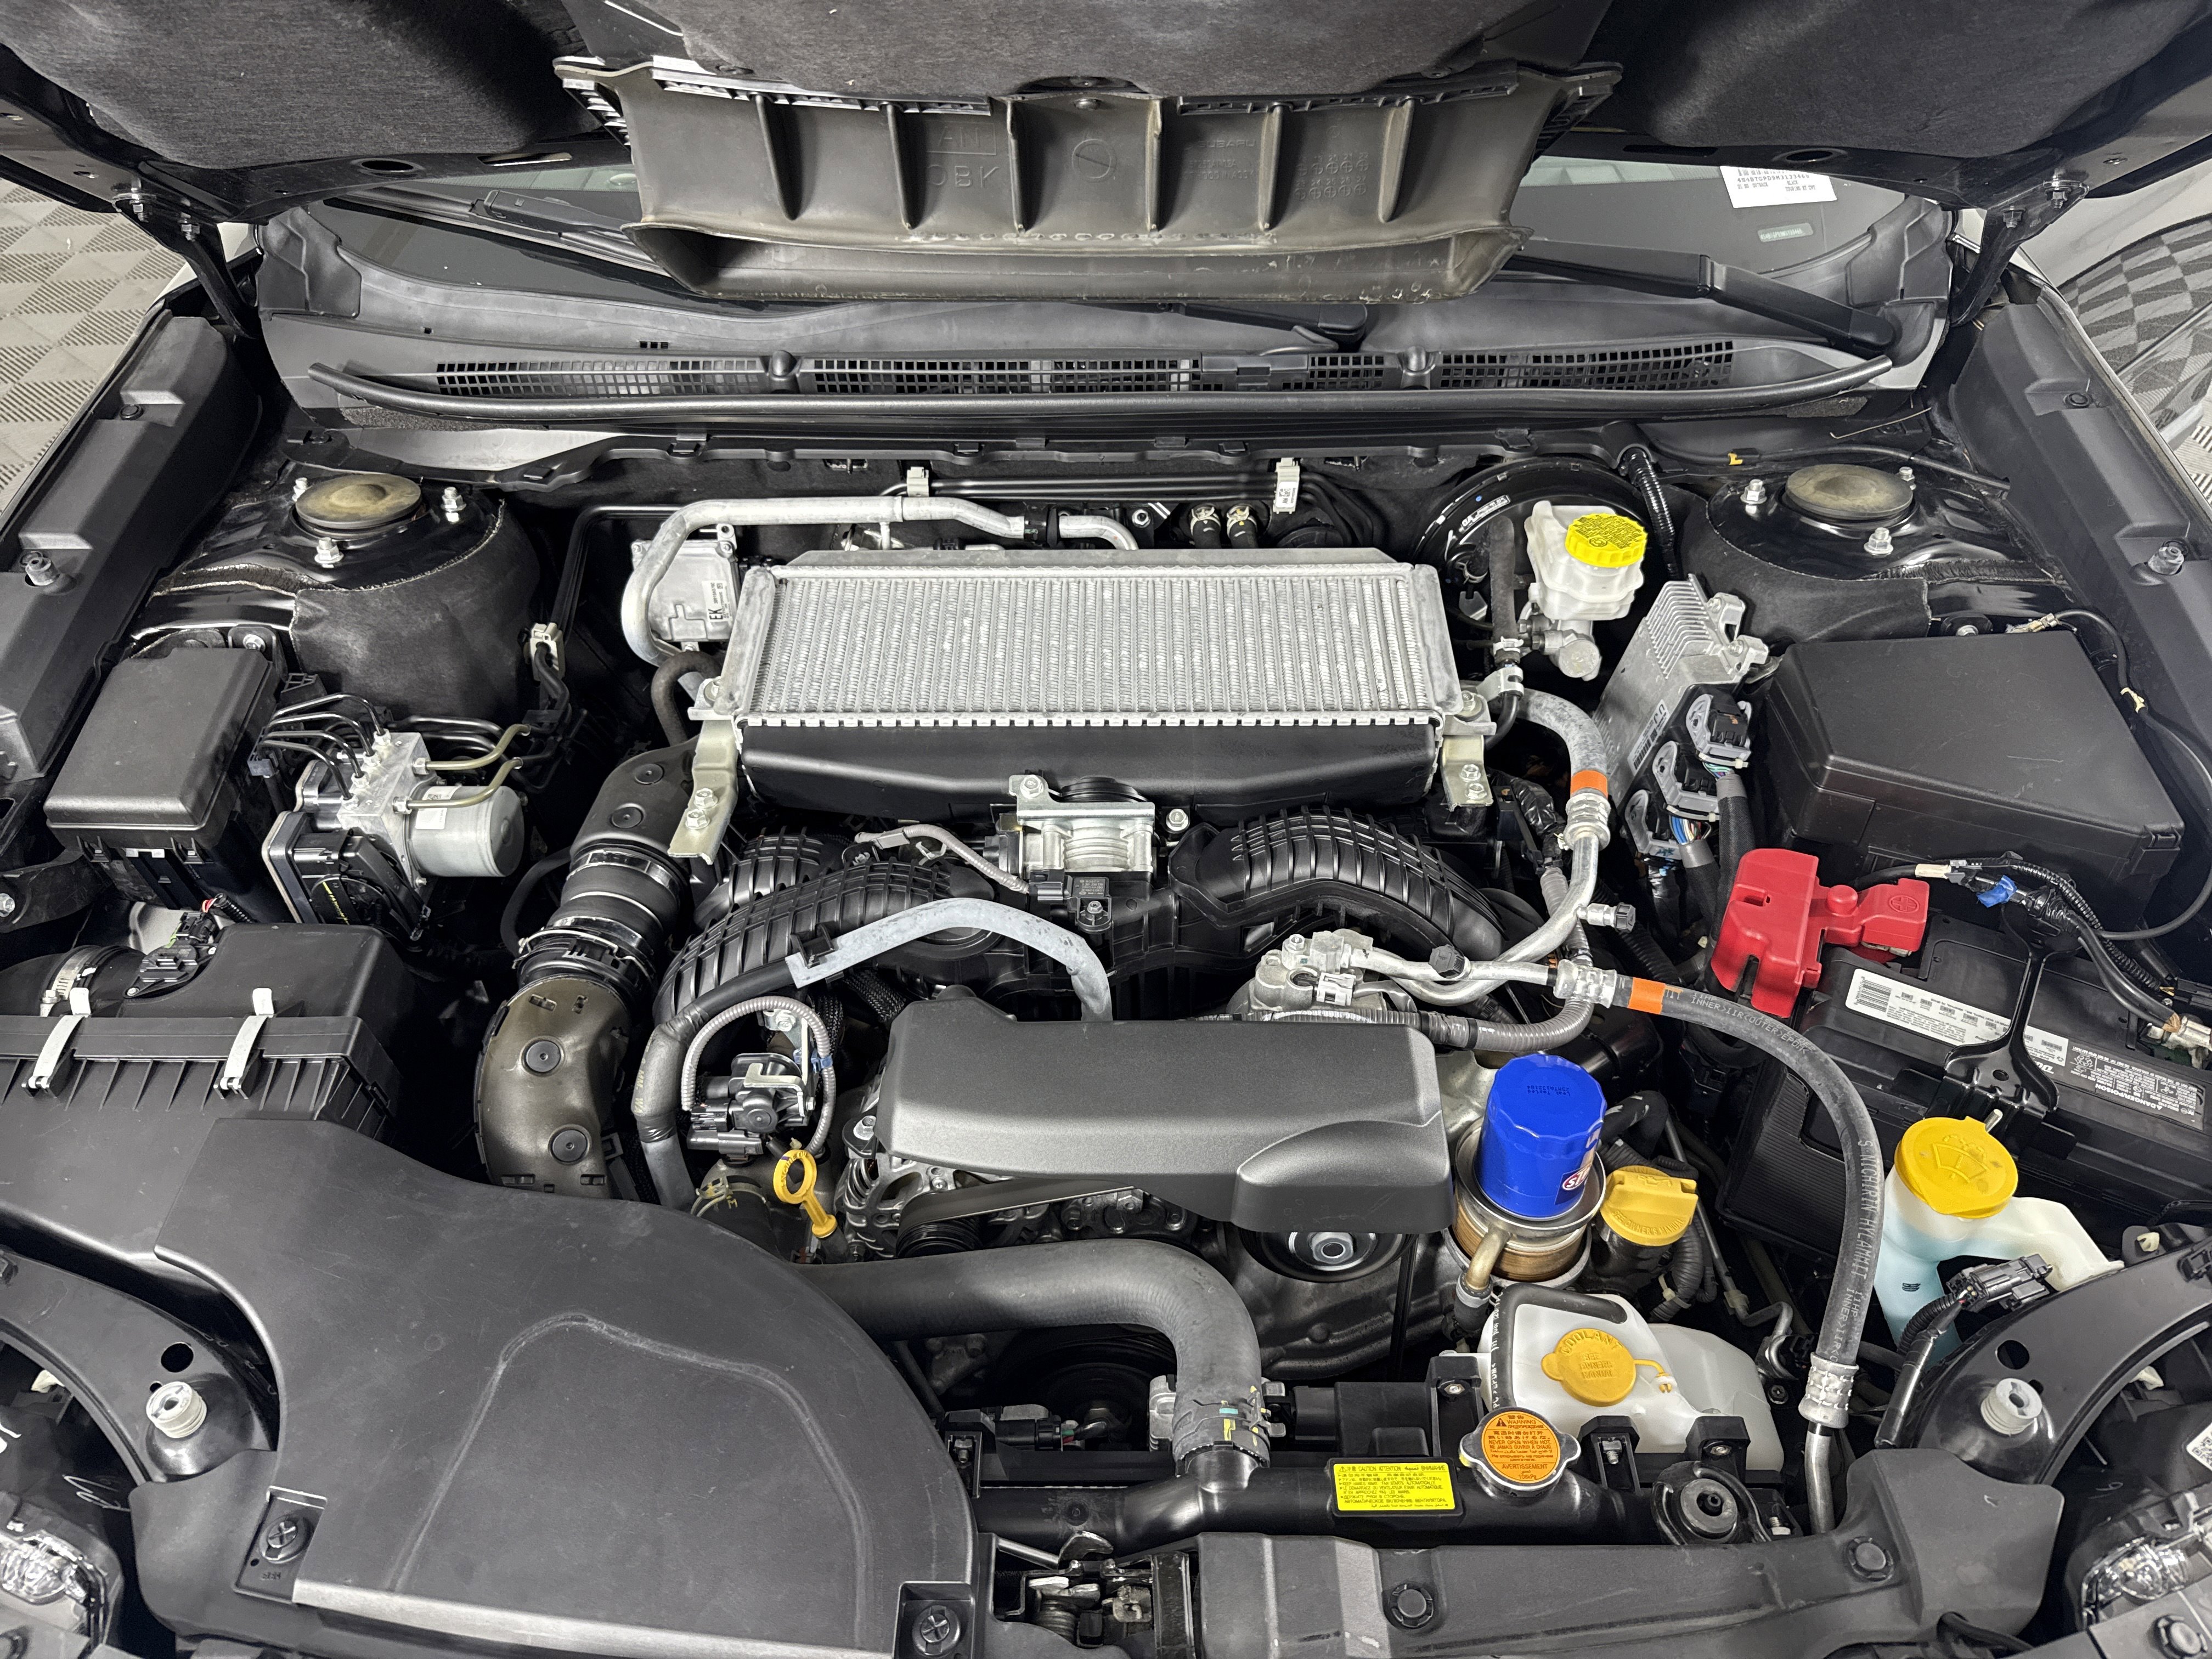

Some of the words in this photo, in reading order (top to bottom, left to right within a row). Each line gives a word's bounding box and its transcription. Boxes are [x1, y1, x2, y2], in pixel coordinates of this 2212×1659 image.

[1198, 139, 1256, 148] SUBARU
[926, 164, 1000, 188] OBK
[708, 608, 723, 619] EK
[1611, 1210, 1627, 1223] SEE
[1625, 1220, 1658, 1235] OWNER'S
[1658, 1216, 1686, 1235] MANUAL
[1851, 1217, 1877, 1280] HYLAMMIT
[1559, 1330, 1624, 1357] COOLANT
[1583, 1353, 1599, 1361] SEE
